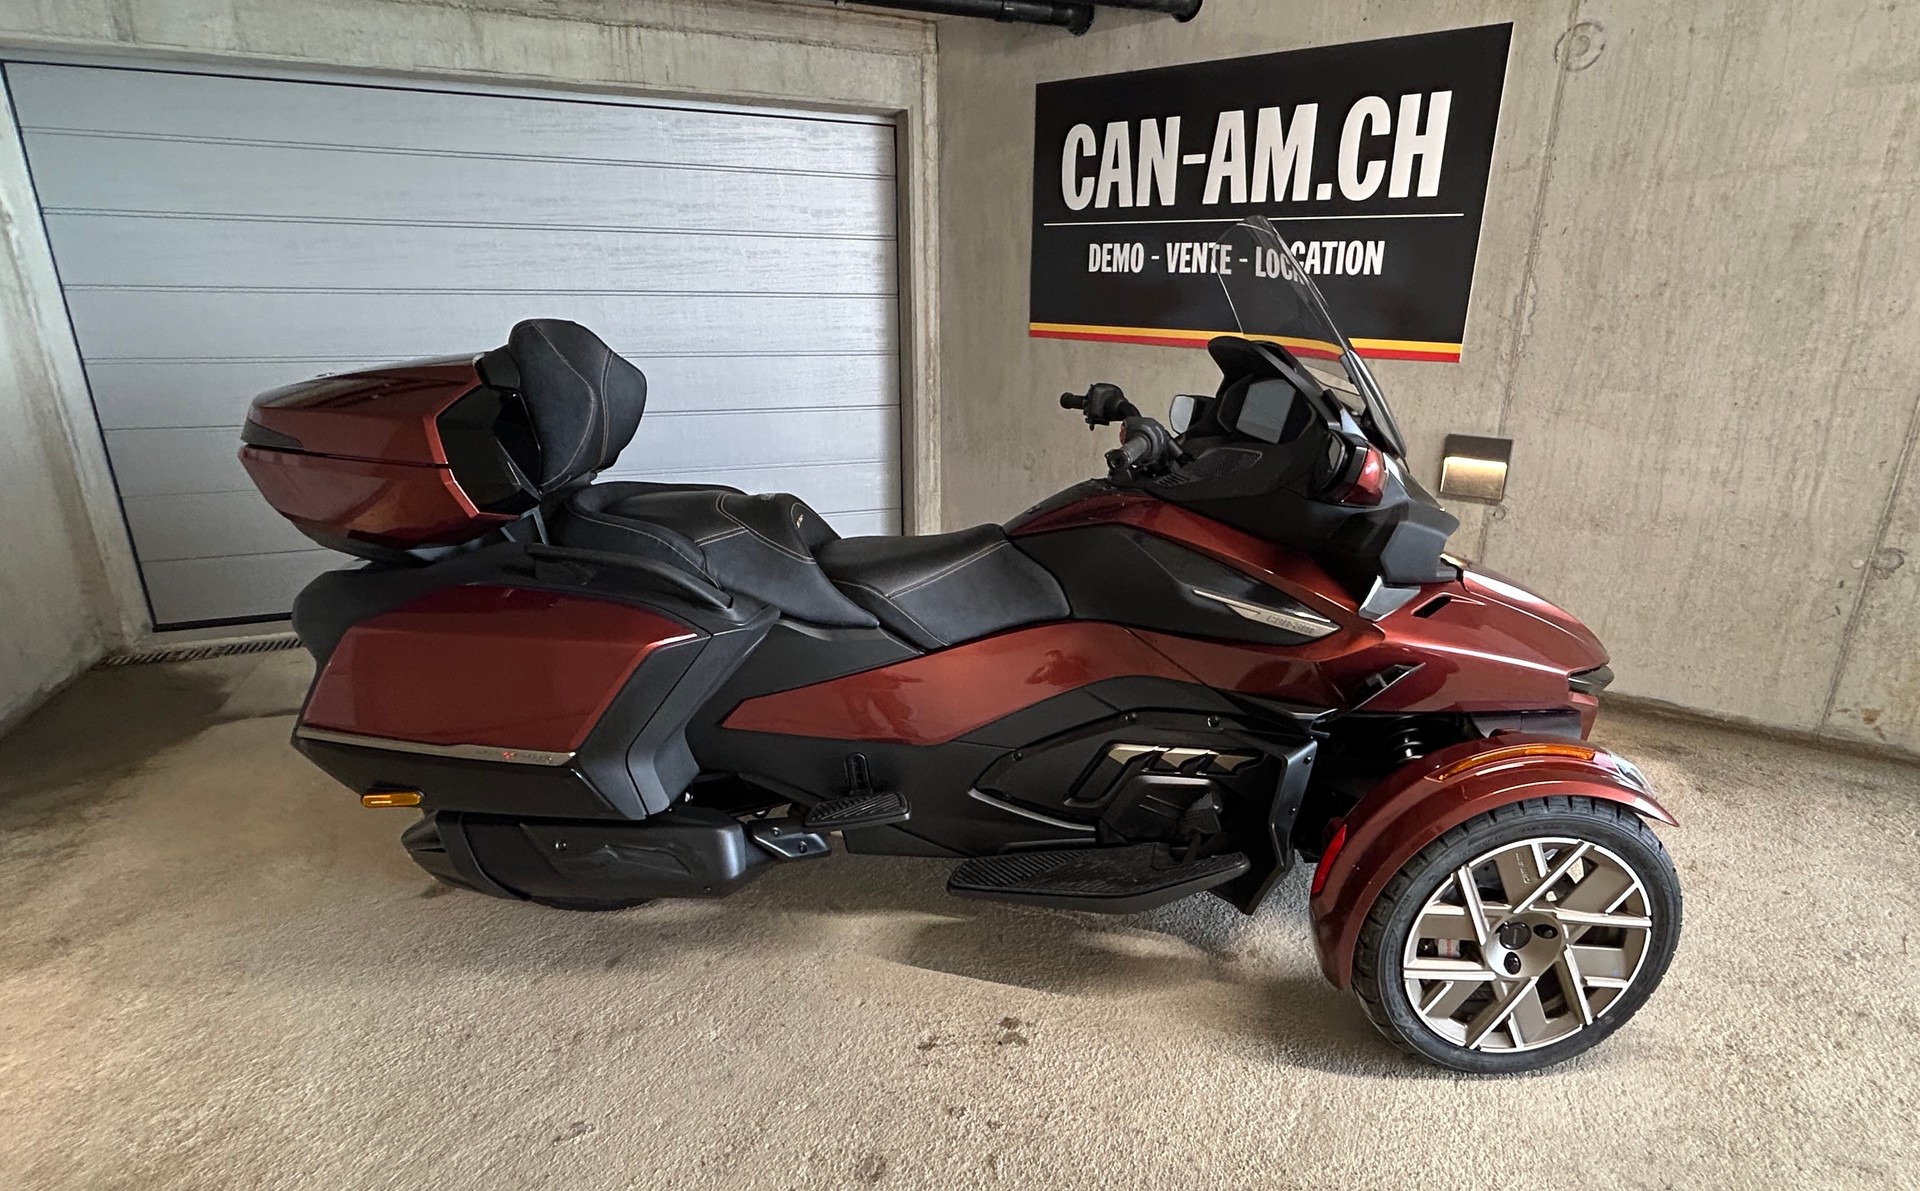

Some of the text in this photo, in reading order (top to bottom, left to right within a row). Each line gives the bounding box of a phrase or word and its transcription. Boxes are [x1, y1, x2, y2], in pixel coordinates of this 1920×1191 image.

[1061, 90, 1453, 211] CAN-AM.CH
[1088, 242, 1145, 274] DEMO
[1166, 242, 1233, 275] VENTE
